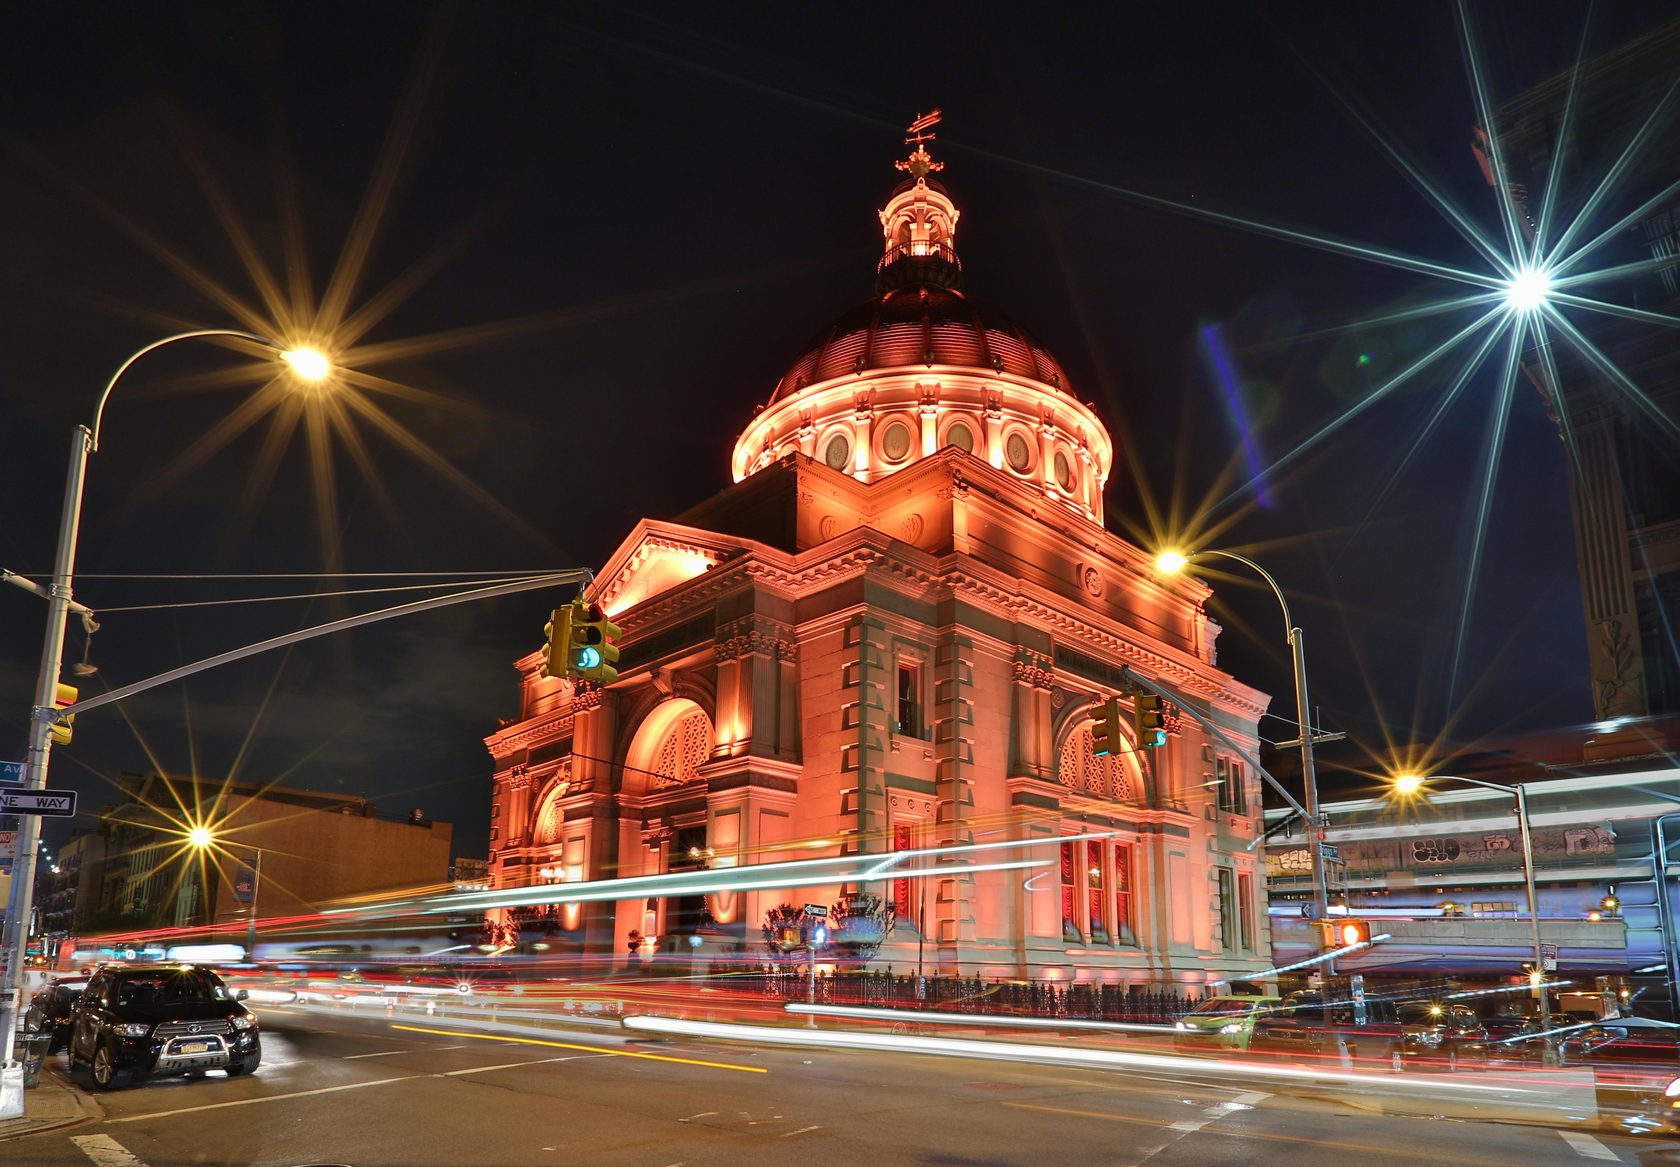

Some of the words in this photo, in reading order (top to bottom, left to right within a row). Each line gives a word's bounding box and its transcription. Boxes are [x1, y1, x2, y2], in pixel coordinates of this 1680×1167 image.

[4, 764, 20, 773] Av
[0, 796, 18, 807] NE
[36, 797, 67, 808] WAY
